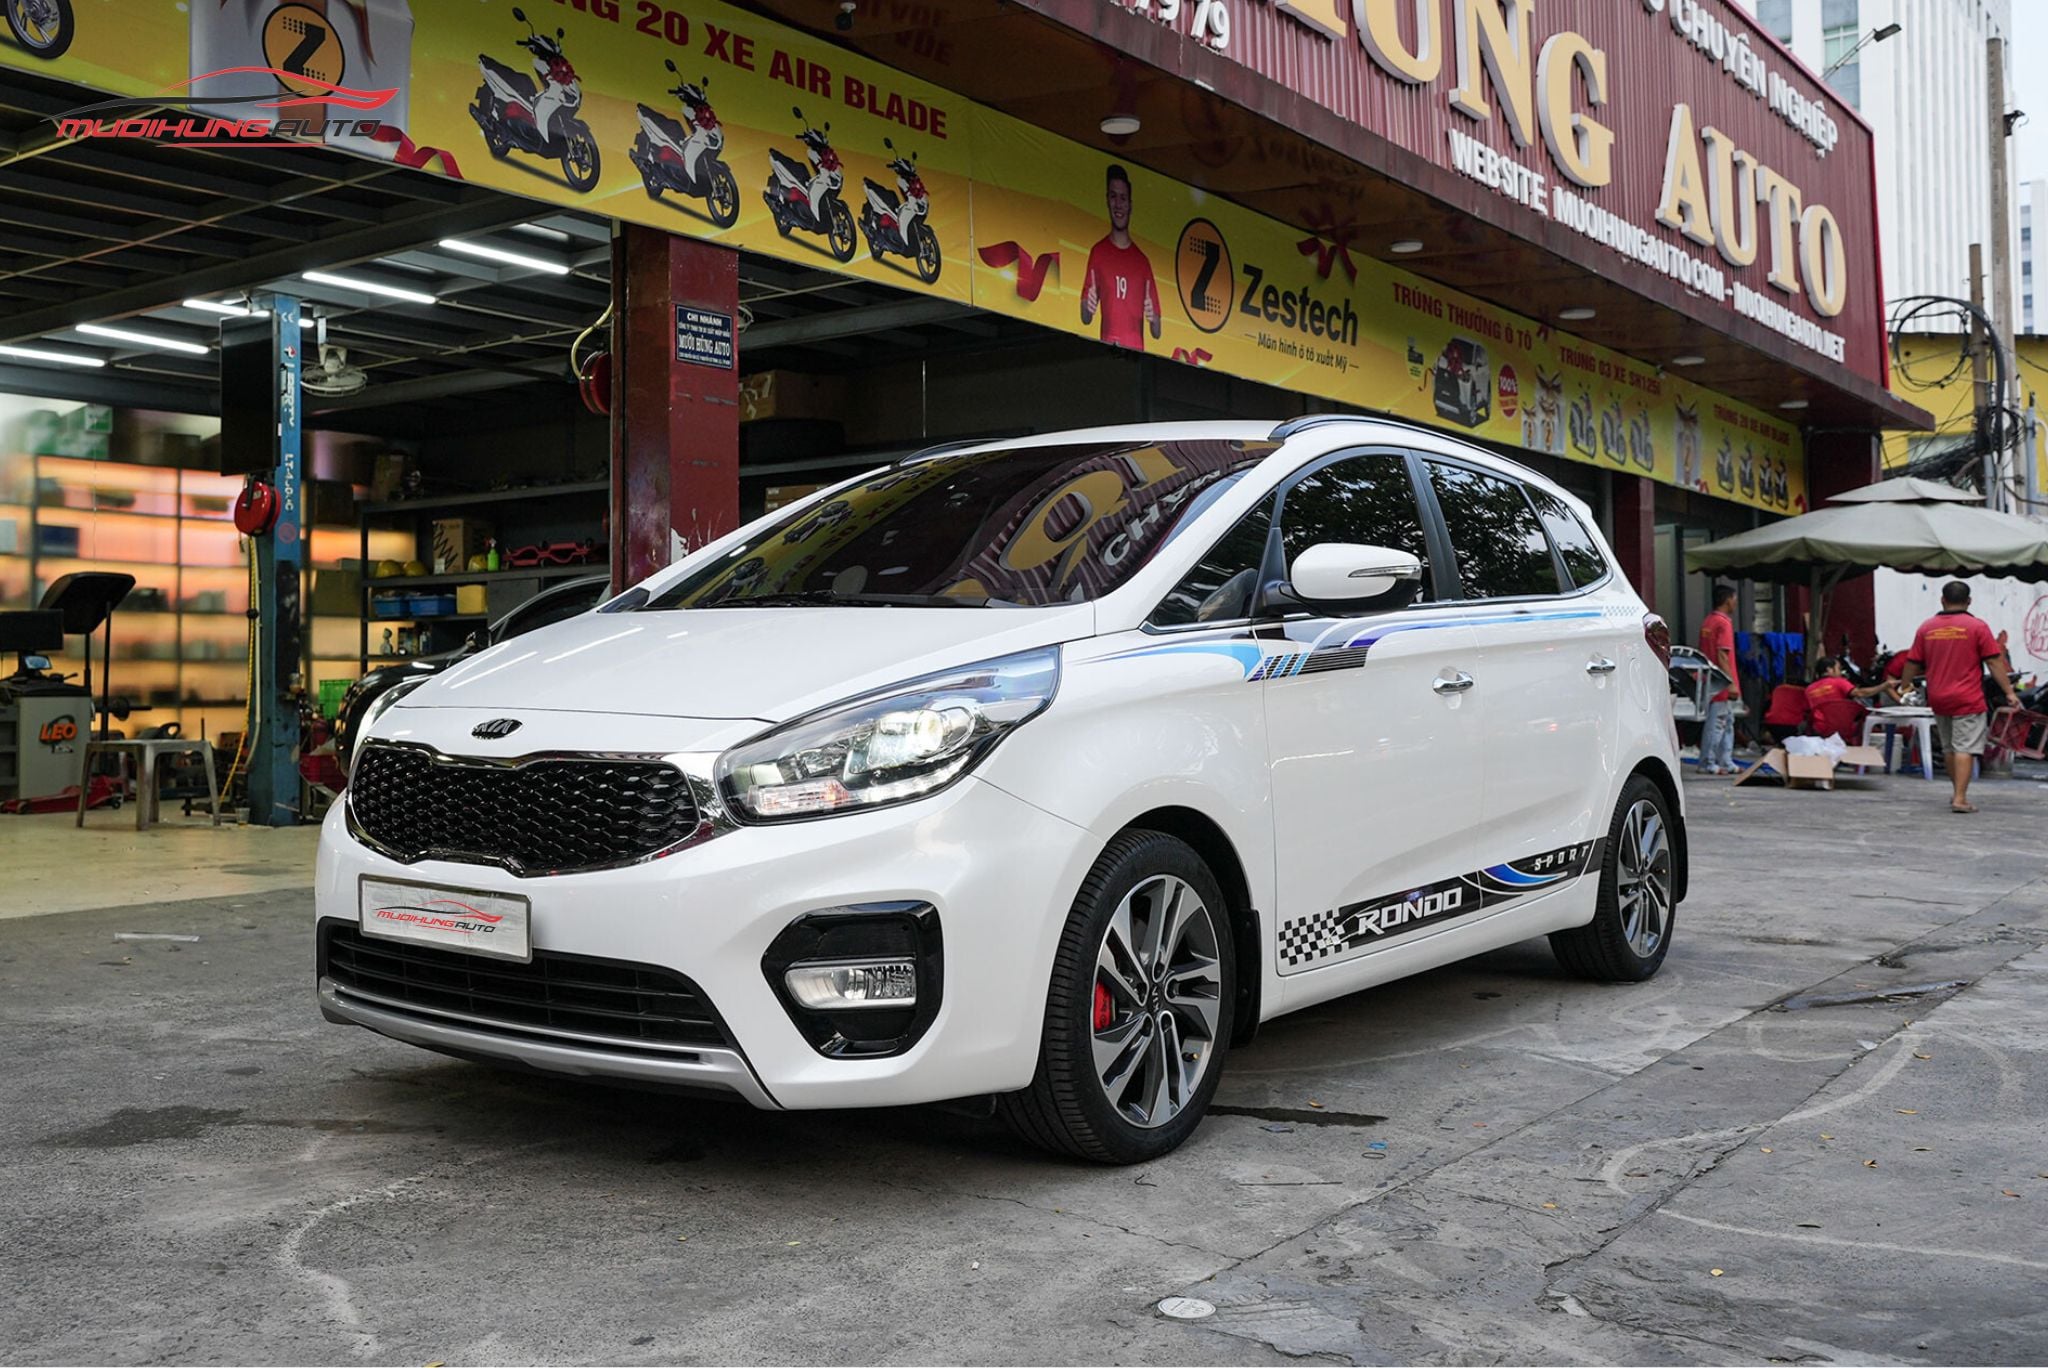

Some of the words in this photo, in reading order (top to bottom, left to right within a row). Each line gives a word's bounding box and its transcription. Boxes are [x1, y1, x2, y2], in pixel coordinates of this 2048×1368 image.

[636, 0, 689, 46] 20
[703, 22, 755, 72] XE
[769, 51, 832, 100] AIR
[844, 75, 948, 140] BLADE
[1768, 72, 1838, 158] NGHIỆP
[1655, 103, 1847, 318] AUTO
[1115, 275, 1128, 300] 19
[1240, 263, 1358, 346] Zestech
[1392, 282, 1442, 319] TRÚNG
[1517, 329, 1533, 350] TÔ
[39, 720, 78, 743] LEO
[1534, 845, 1589, 871] SPORT
[1355, 887, 1463, 936] RONDO
